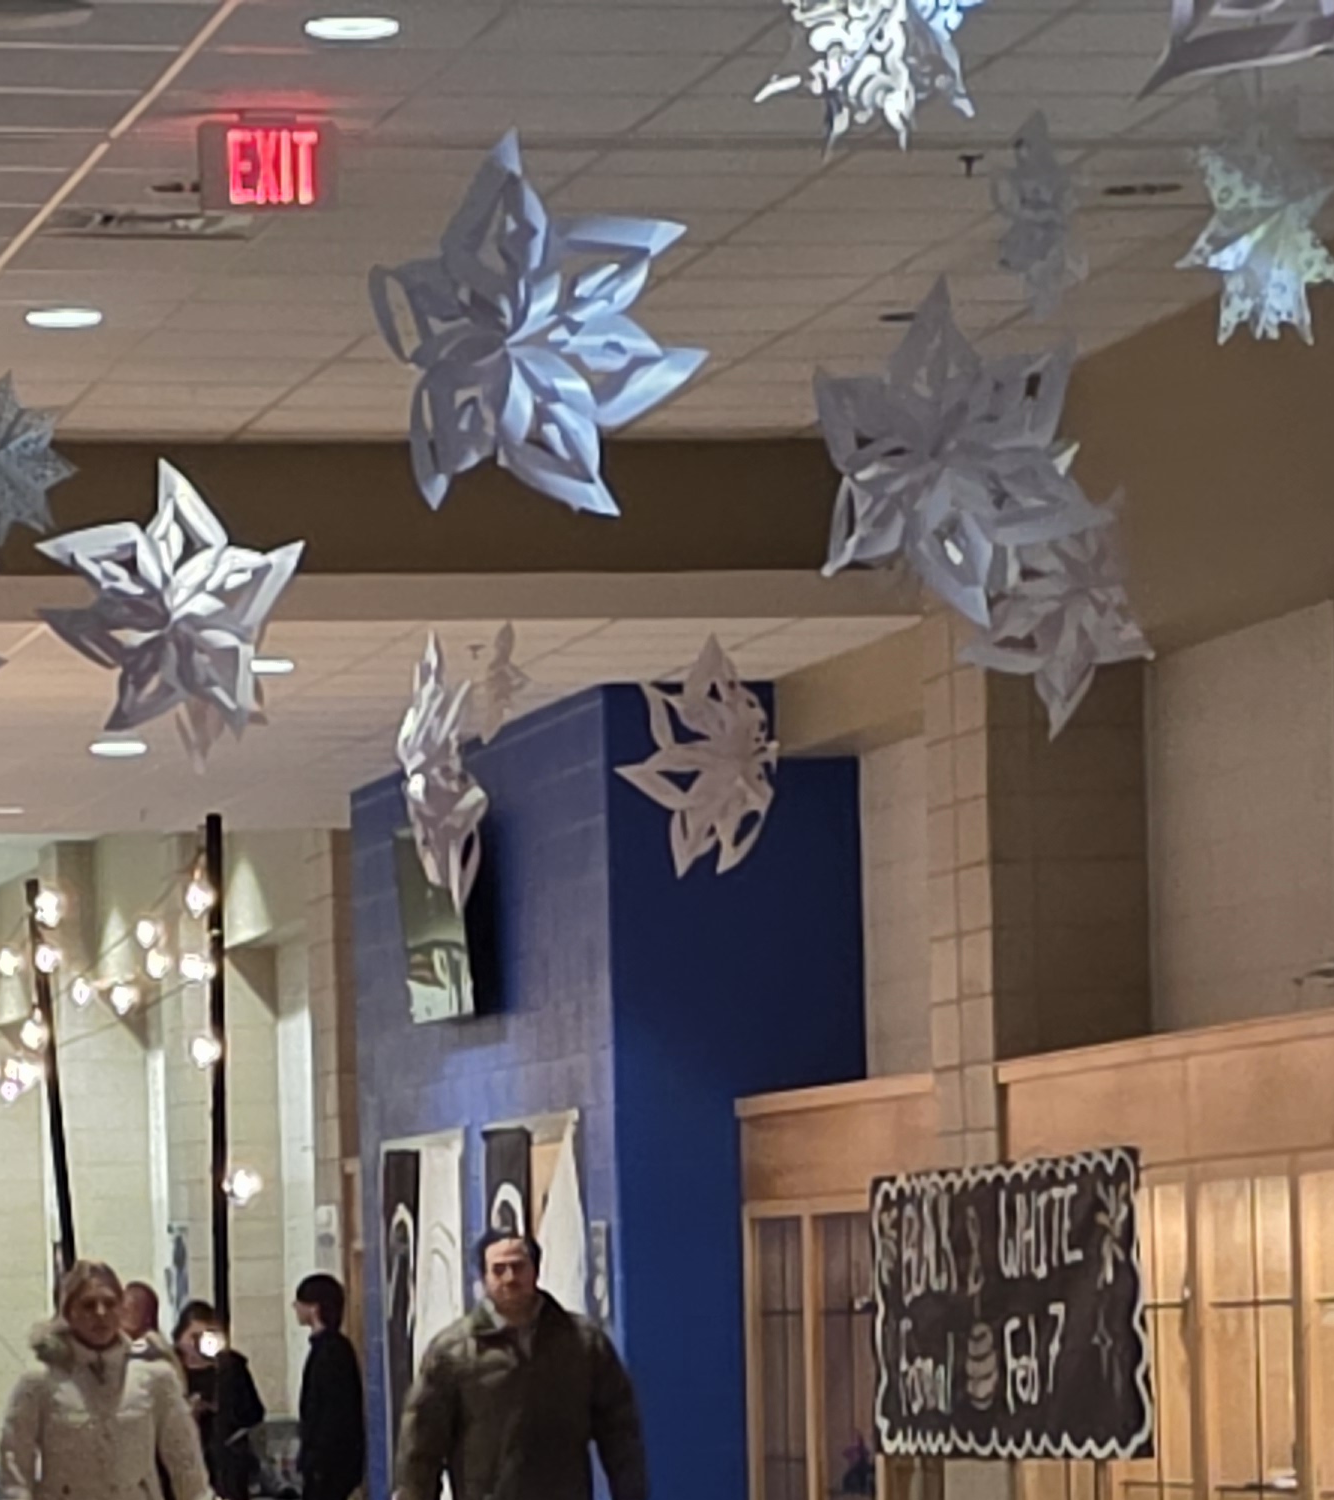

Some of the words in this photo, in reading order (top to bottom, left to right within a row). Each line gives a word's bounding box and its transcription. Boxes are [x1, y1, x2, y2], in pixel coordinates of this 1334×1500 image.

[227, 129, 317, 204] EXIT
[999, 1184, 1083, 1279] WHITE
[1048, 1302, 1066, 1393] 7
